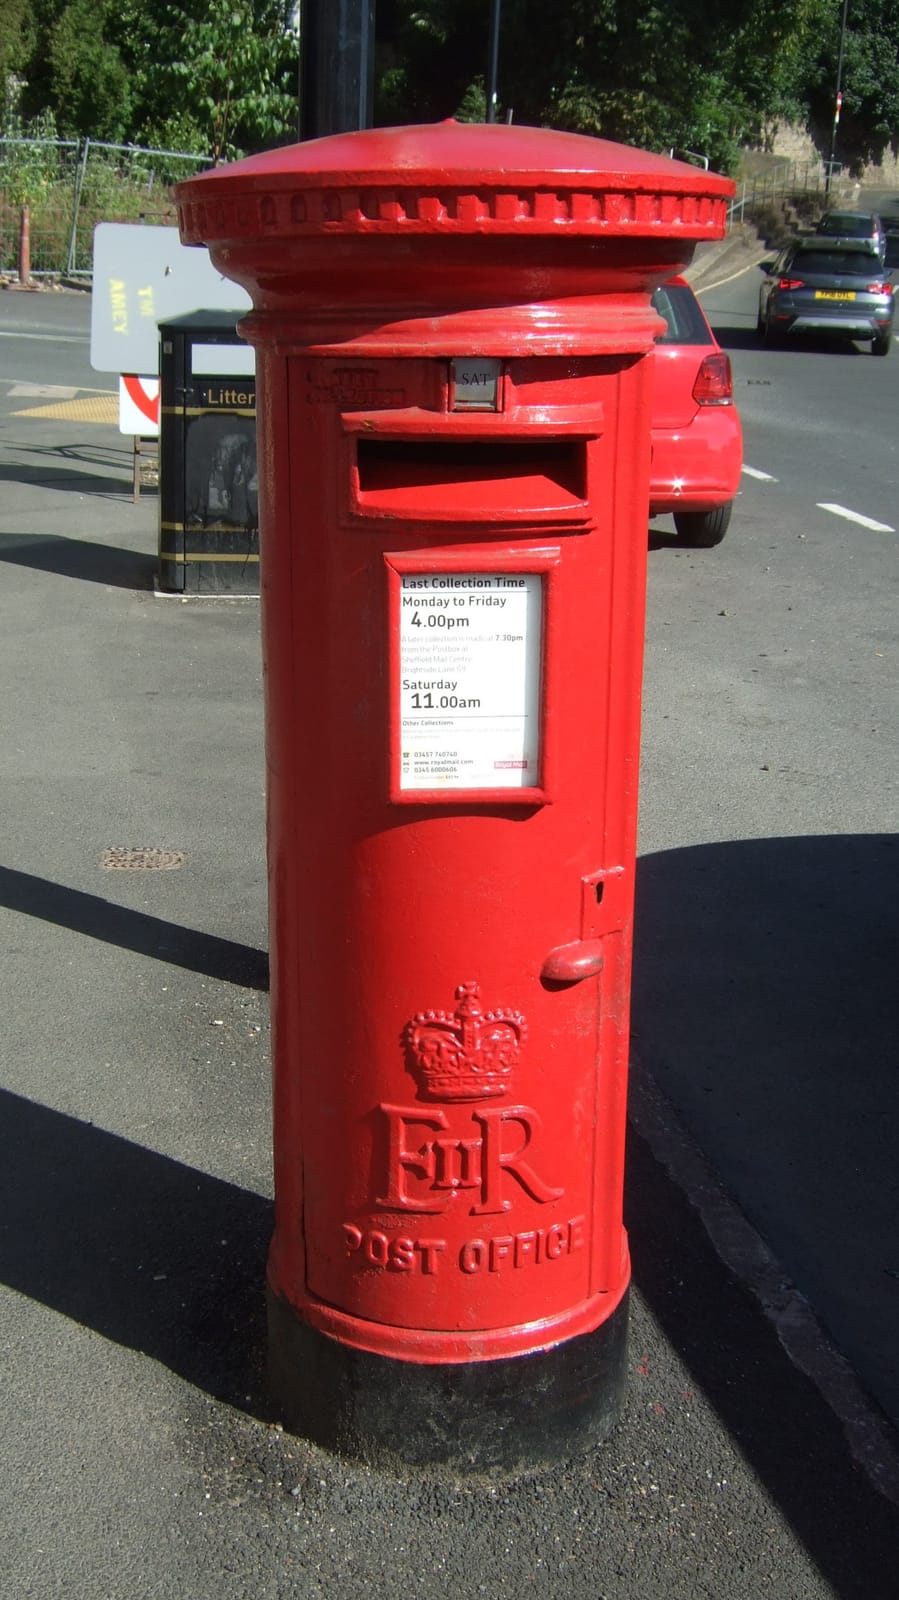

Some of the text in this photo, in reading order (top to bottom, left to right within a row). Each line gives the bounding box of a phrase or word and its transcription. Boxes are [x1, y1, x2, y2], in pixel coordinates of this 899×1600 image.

[109, 279, 128, 336] AMEY
[461, 372, 490, 386] SAT
[207, 388, 256, 405] Litter
[402, 576, 526, 589] Last Collection Time
[402, 595, 507, 609] Monday to Friday
[411, 611, 470, 629] 4.00pm
[495, 634, 524, 643] 7.30pm
[402, 679, 458, 691] Saturday
[411, 692, 481, 709] 11.00am
[343, 1215, 585, 1275] POST OFFICE
